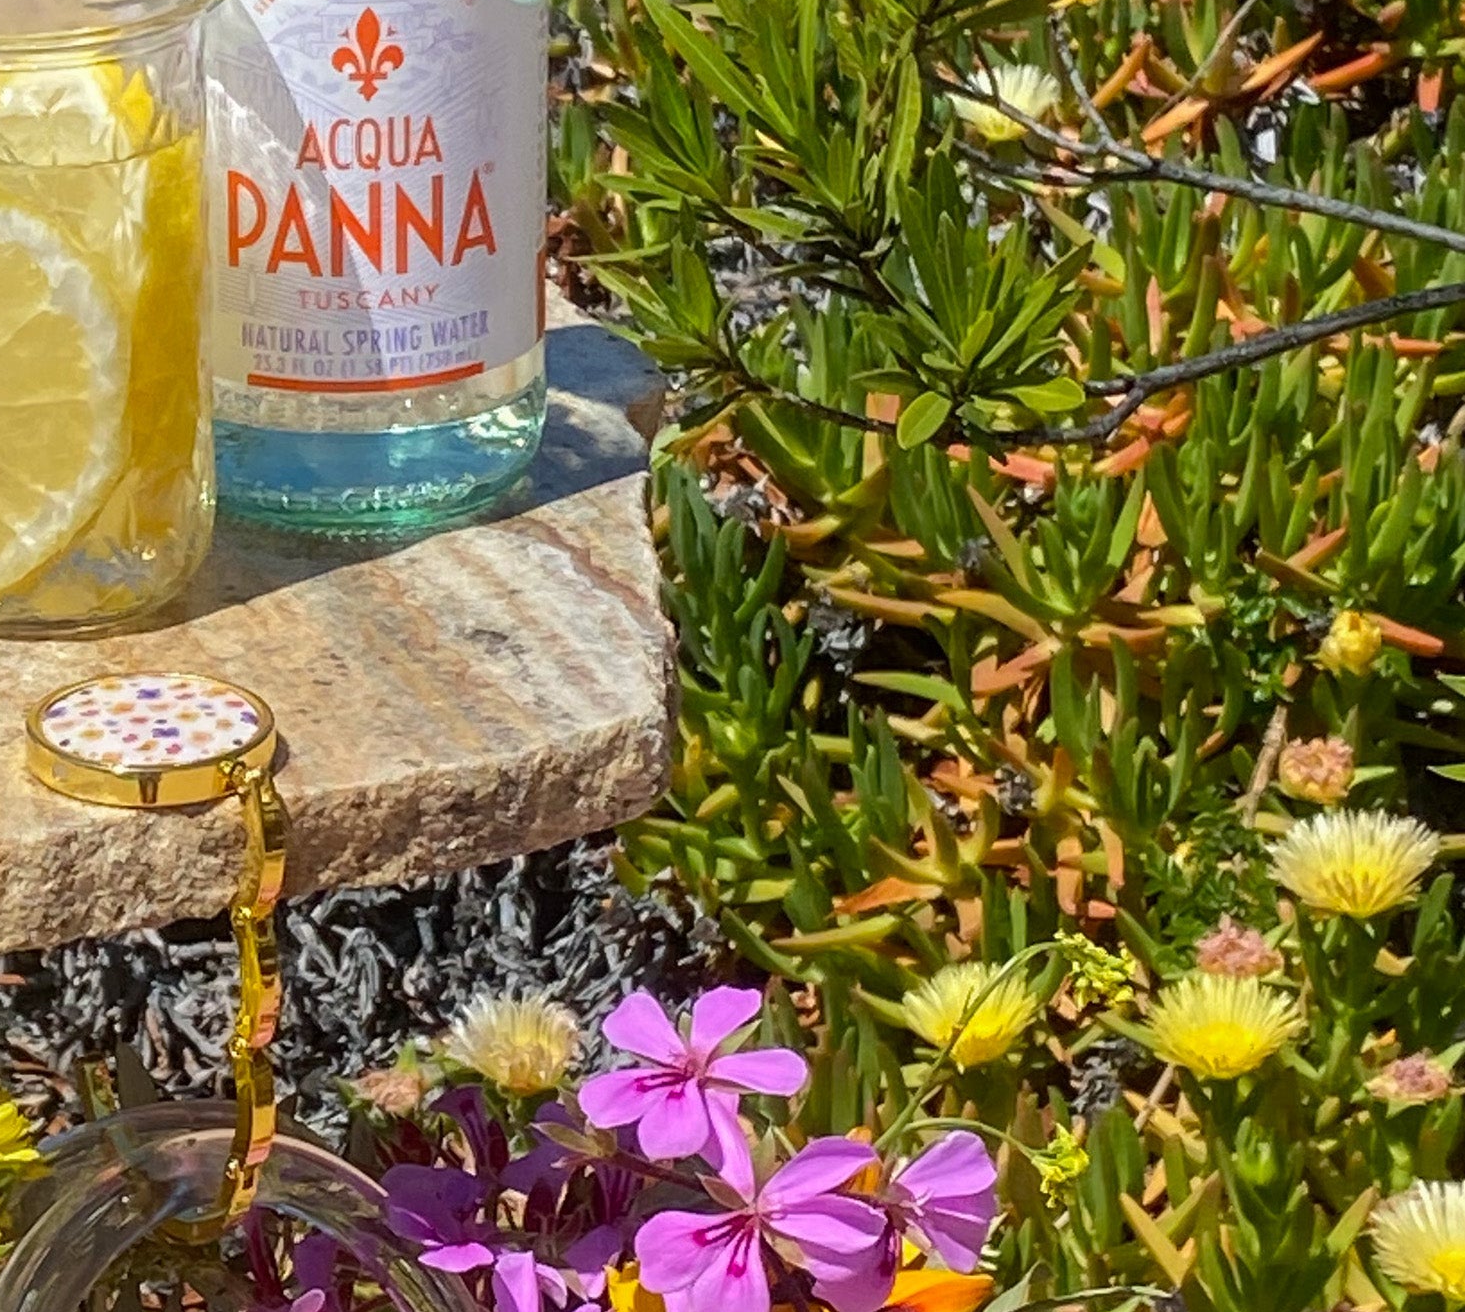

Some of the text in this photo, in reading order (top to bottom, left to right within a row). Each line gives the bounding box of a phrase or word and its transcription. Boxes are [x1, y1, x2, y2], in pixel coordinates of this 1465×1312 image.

[296, 114, 443, 171] ACQUA
[228, 168, 497, 278] PANNA
[299, 283, 440, 310] TUSCANY
[242, 310, 491, 356] NATURAL SPRING WATER
